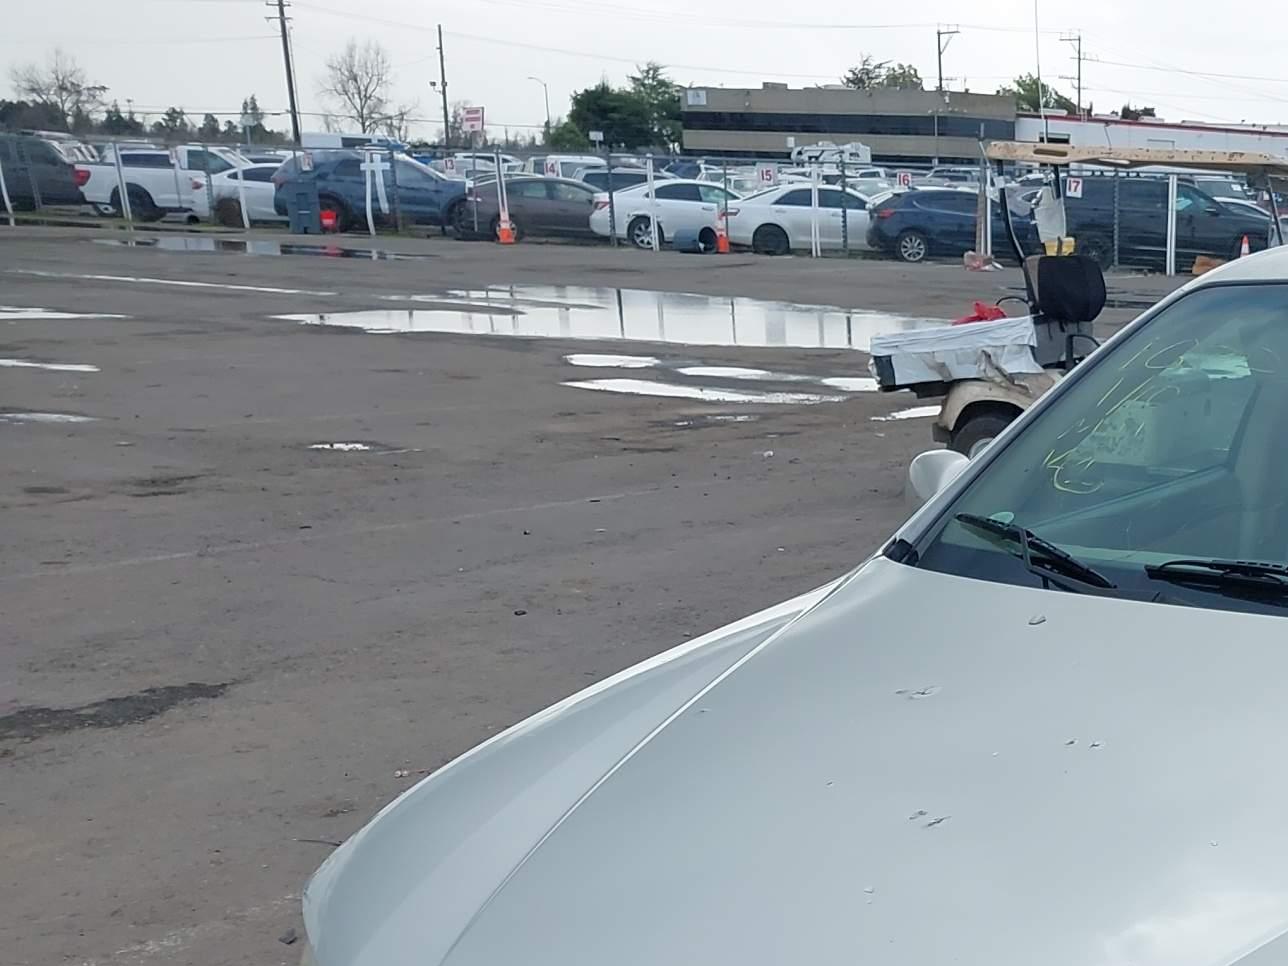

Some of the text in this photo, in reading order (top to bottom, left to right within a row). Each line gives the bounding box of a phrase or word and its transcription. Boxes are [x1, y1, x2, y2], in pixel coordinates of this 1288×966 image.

[444, 159, 455, 170] 13
[760, 169, 772, 181] 15
[898, 174, 909, 186] 16
[1067, 179, 1080, 192] 17
